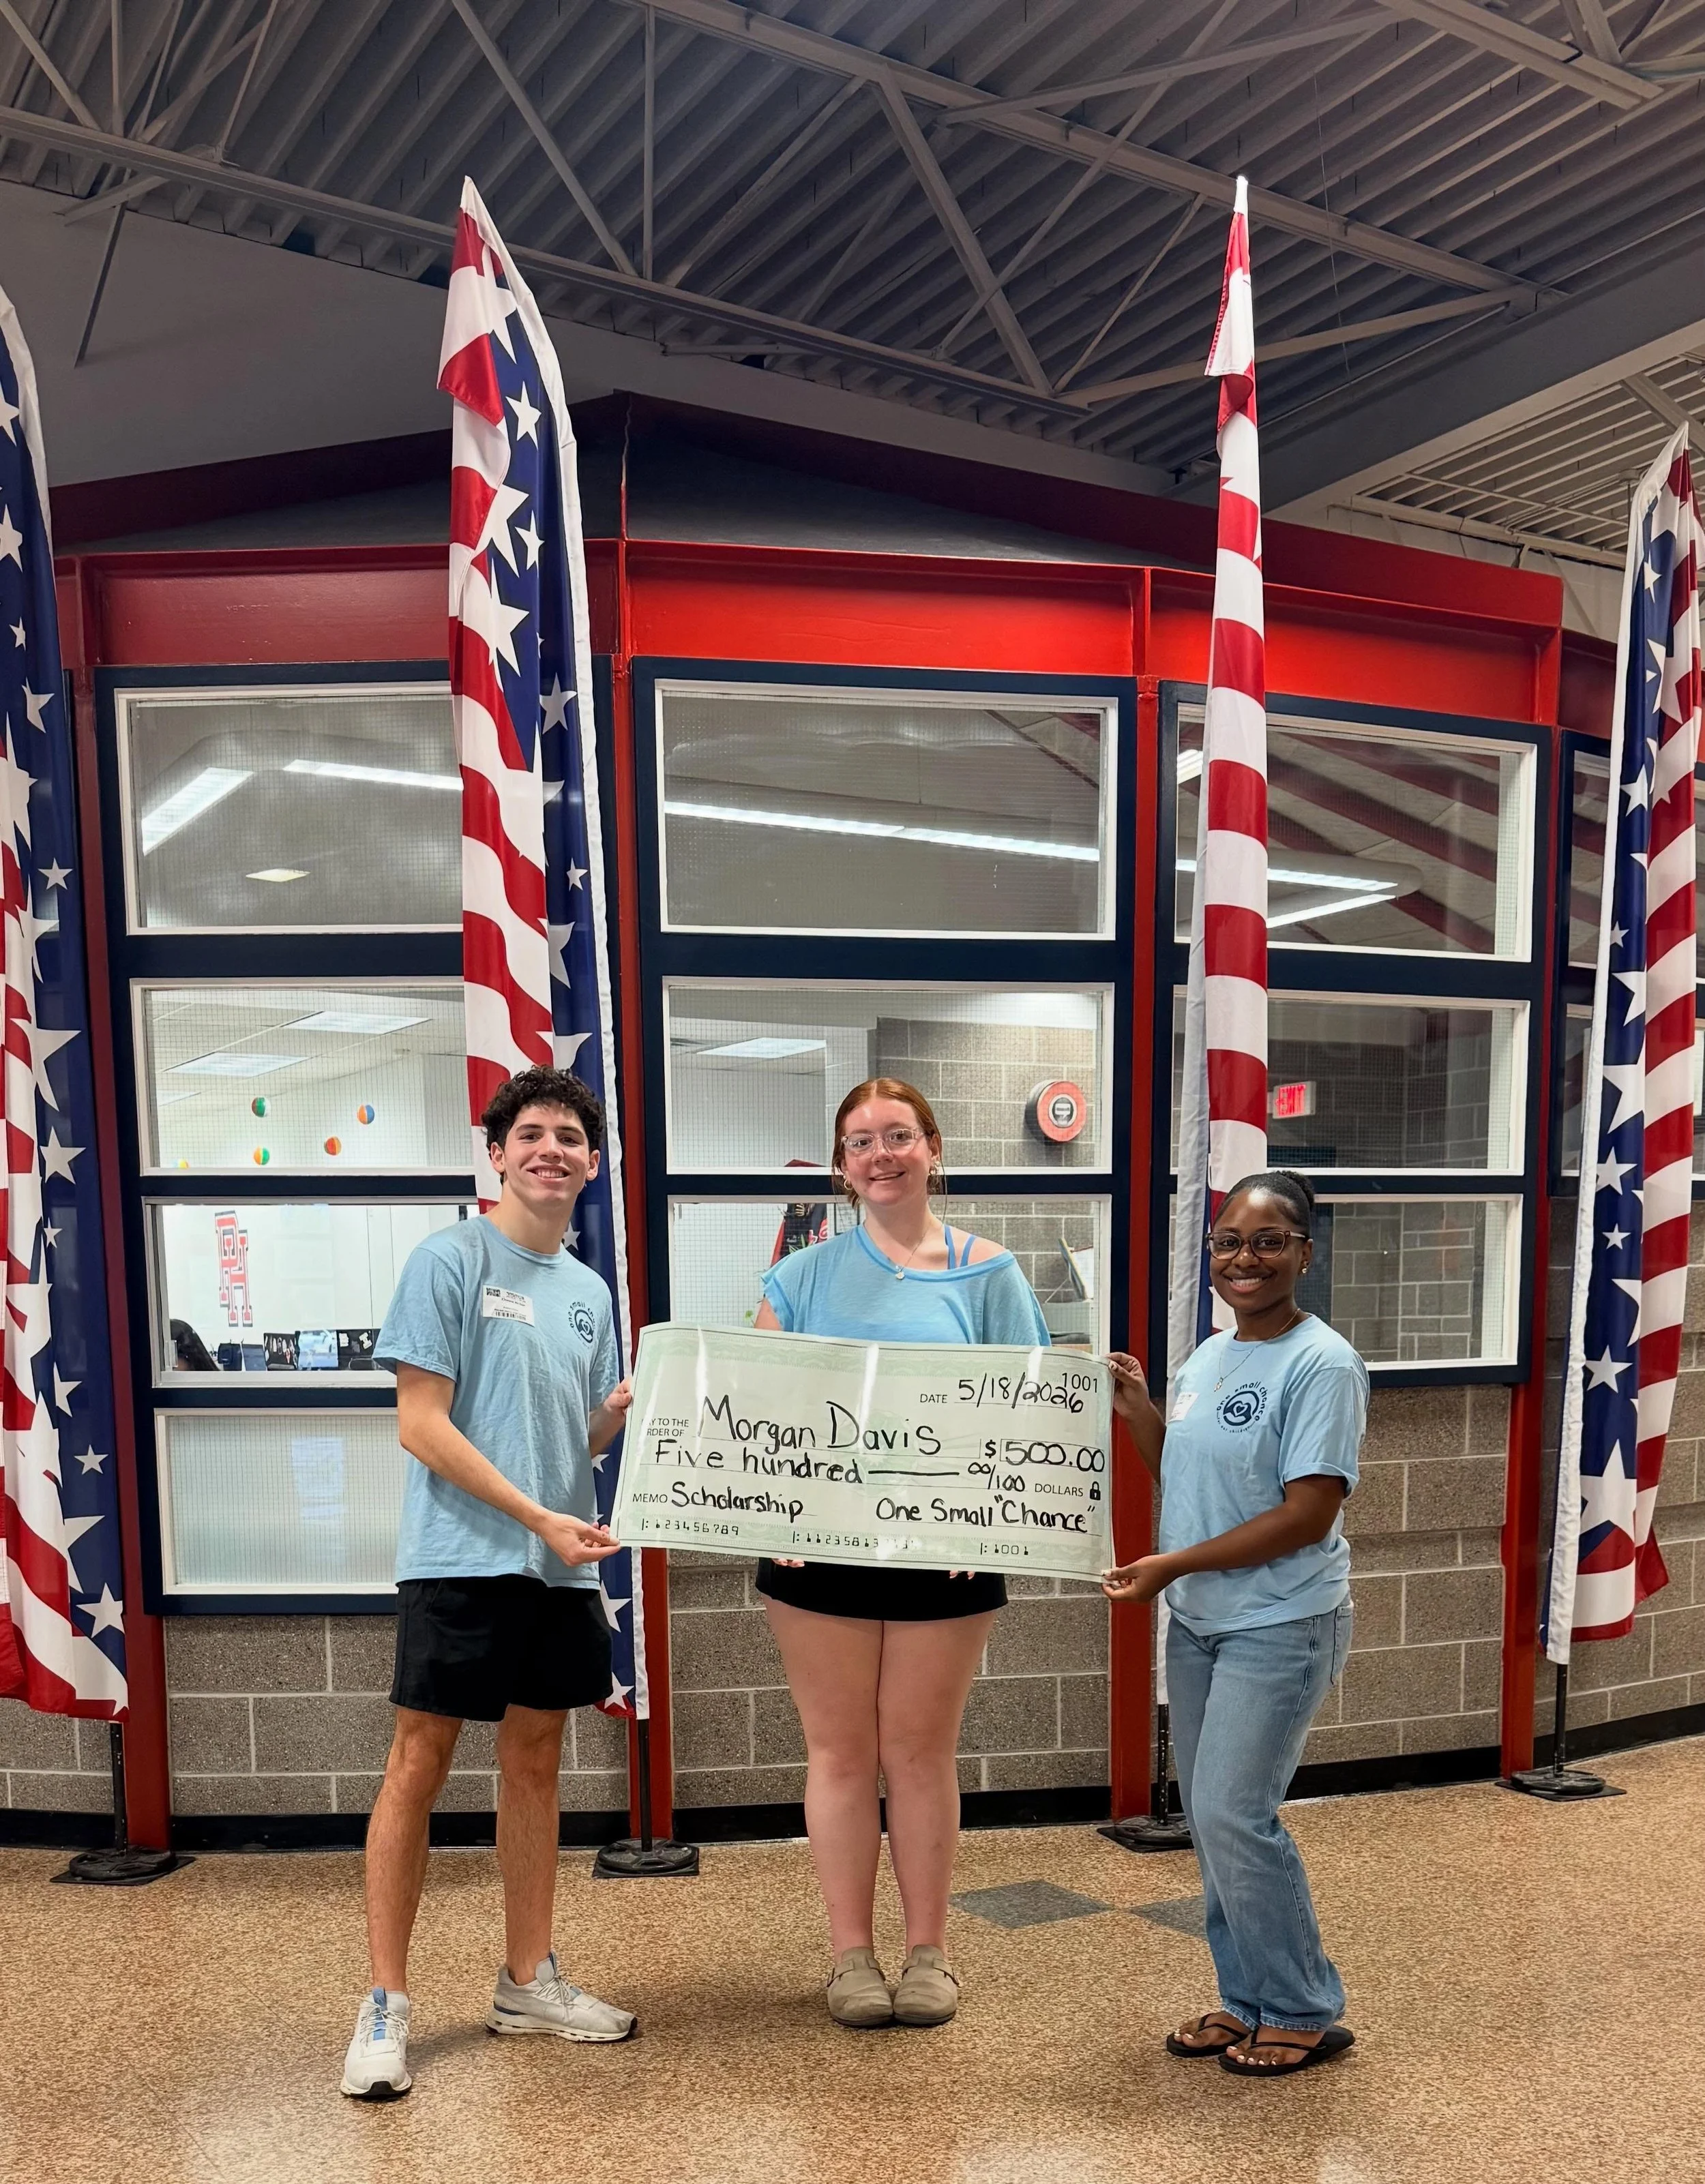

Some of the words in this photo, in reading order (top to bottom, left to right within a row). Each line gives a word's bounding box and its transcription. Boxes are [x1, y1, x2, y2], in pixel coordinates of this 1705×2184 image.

[919, 1393, 948, 1404] DATE
[958, 1372, 1084, 1413] 5/18/2026
[1062, 1372, 1098, 1393] 1001
[1255, 1386, 1269, 1422] chance
[647, 1428, 670, 1437] RDER
[672, 1428, 685, 1437] OF
[657, 1418, 670, 1426] TO
[671, 1418, 690, 1428] THE
[698, 1394, 816, 1455] Morgan
[825, 1400, 942, 1456] Davis
[655, 1439, 724, 1468] Five
[743, 1446, 863, 1484] hundred
[1034, 1482, 1084, 1497] DOLLARS
[1005, 1441, 1106, 1473] 500.00
[632, 1493, 668, 1504] MEMO
[671, 1480, 804, 1523] Scholarship
[876, 1497, 922, 1521] One
[930, 1497, 993, 1527] Small
